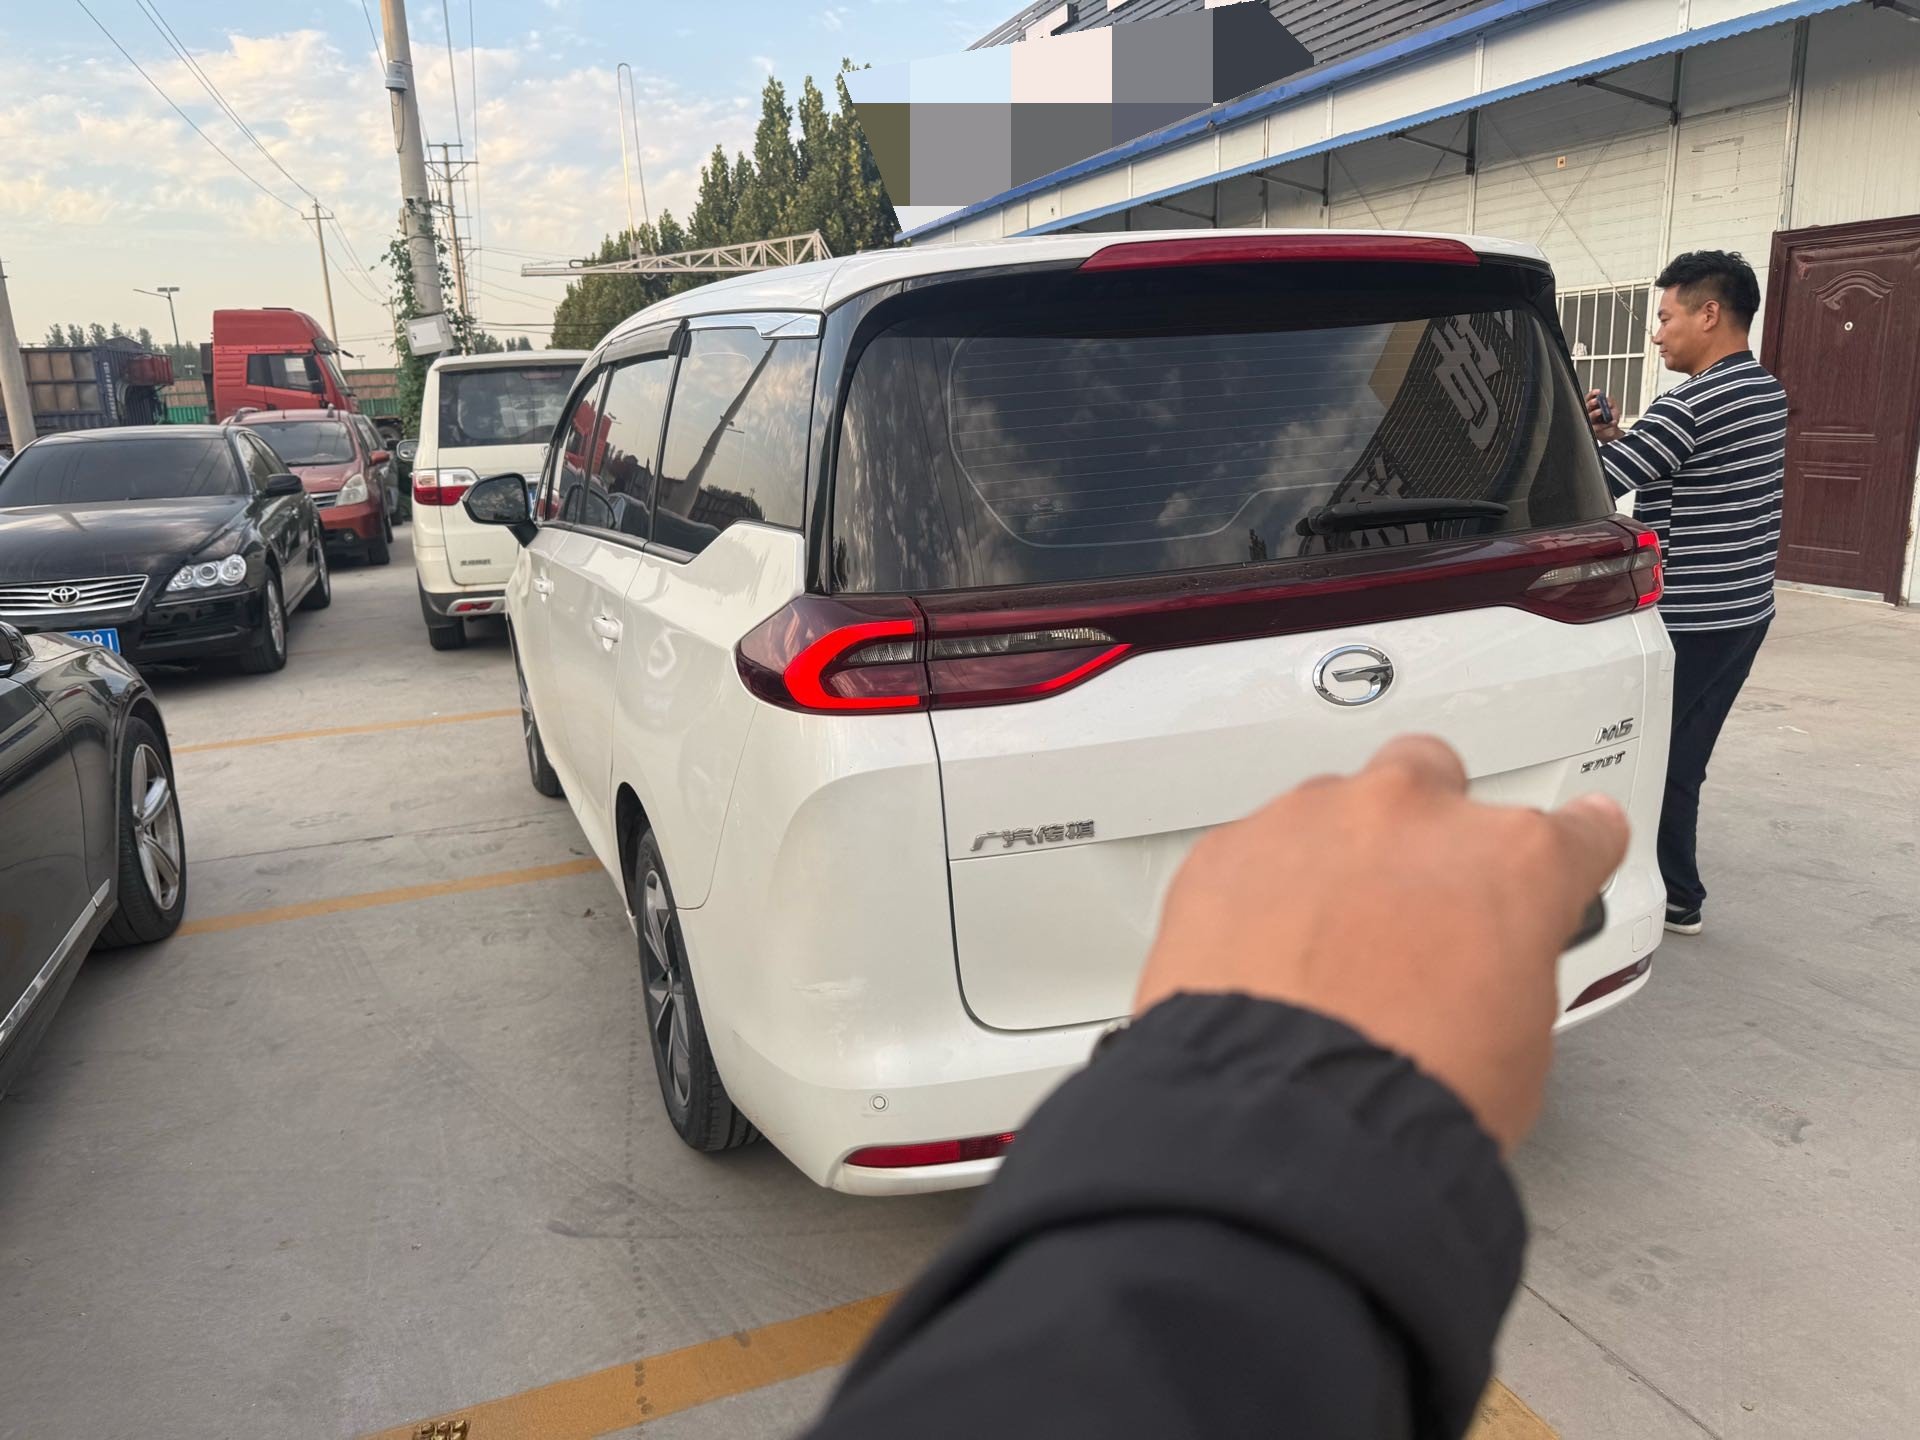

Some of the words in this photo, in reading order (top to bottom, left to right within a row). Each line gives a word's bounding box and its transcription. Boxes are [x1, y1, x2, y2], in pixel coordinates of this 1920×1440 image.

[1595, 717, 1634, 744] M6
[970, 819, 1095, 851] 广汽传祺
